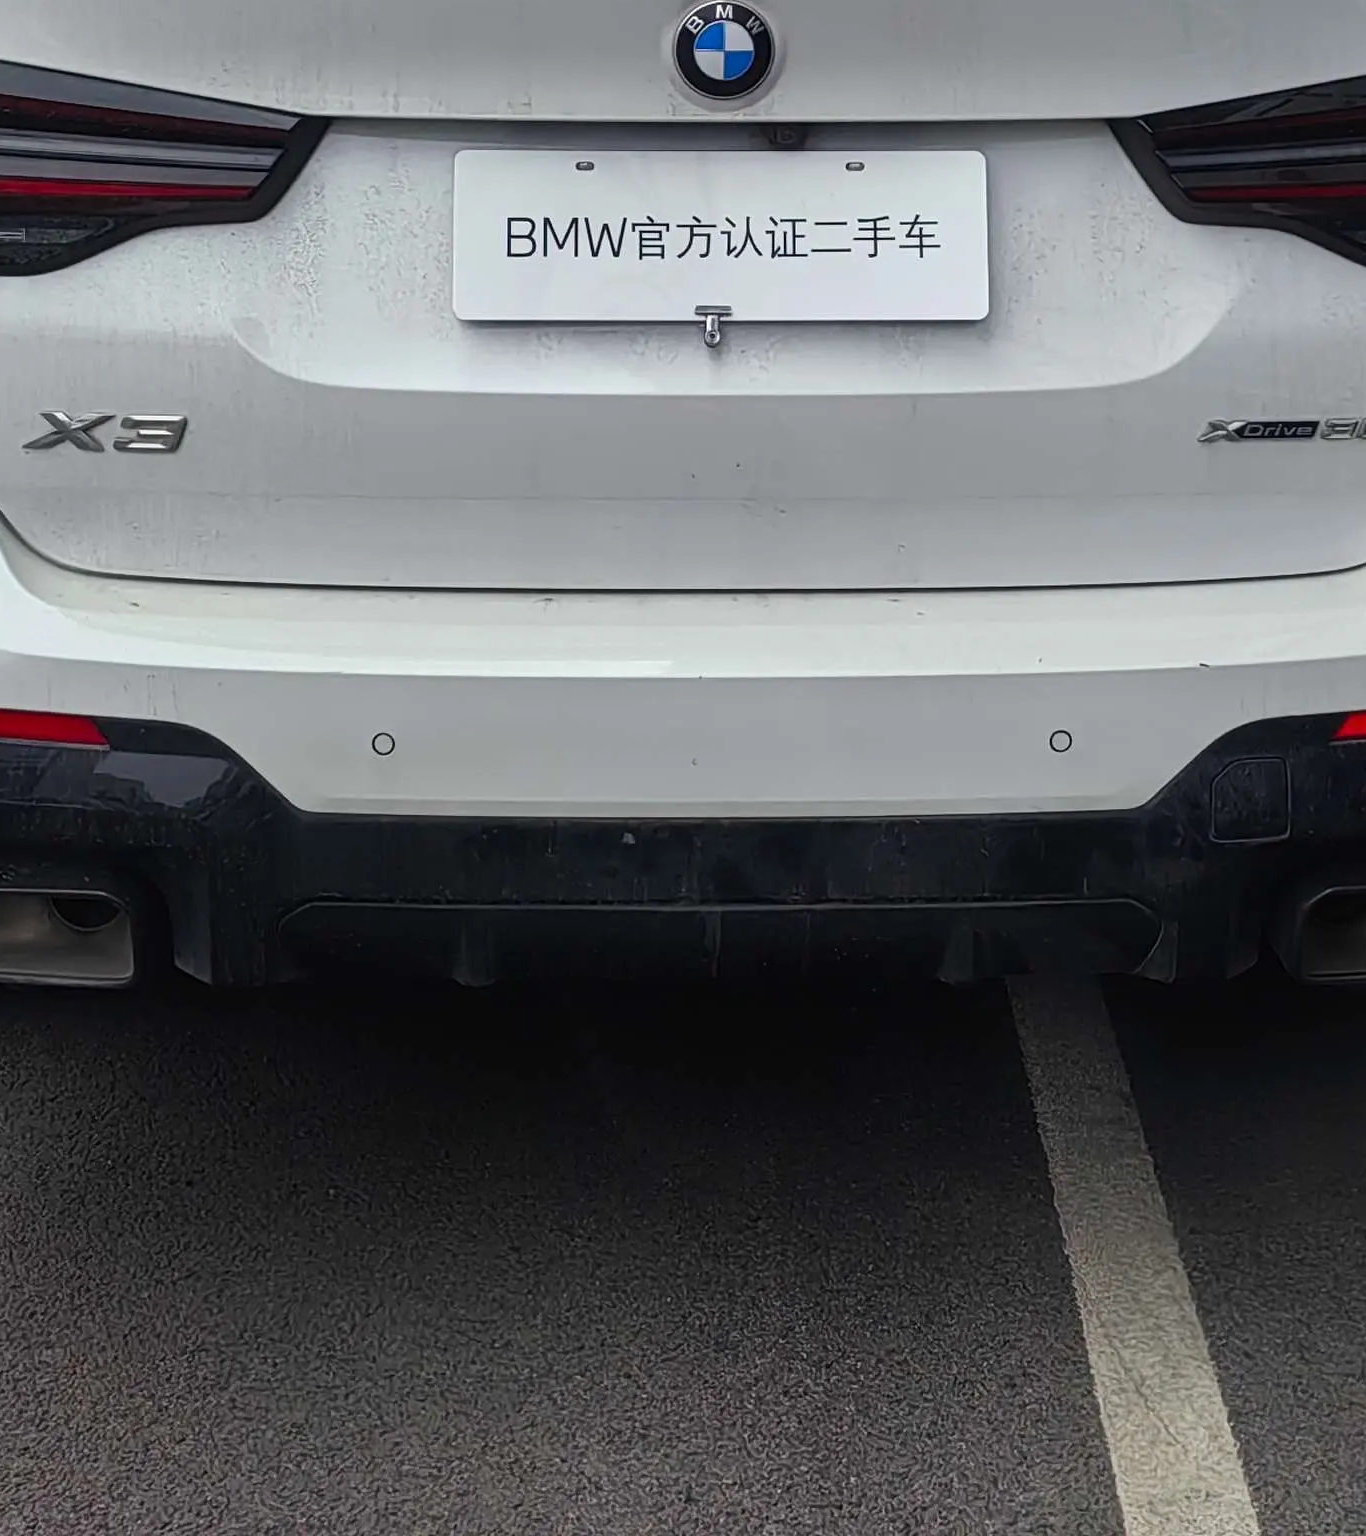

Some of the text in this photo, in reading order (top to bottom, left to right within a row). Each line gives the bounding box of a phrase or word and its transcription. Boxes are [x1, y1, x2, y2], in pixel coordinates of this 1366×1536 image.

[686, 4, 764, 35] BMW
[505, 214, 942, 260] BMW官方认证二手车
[22, 410, 188, 454] X3
